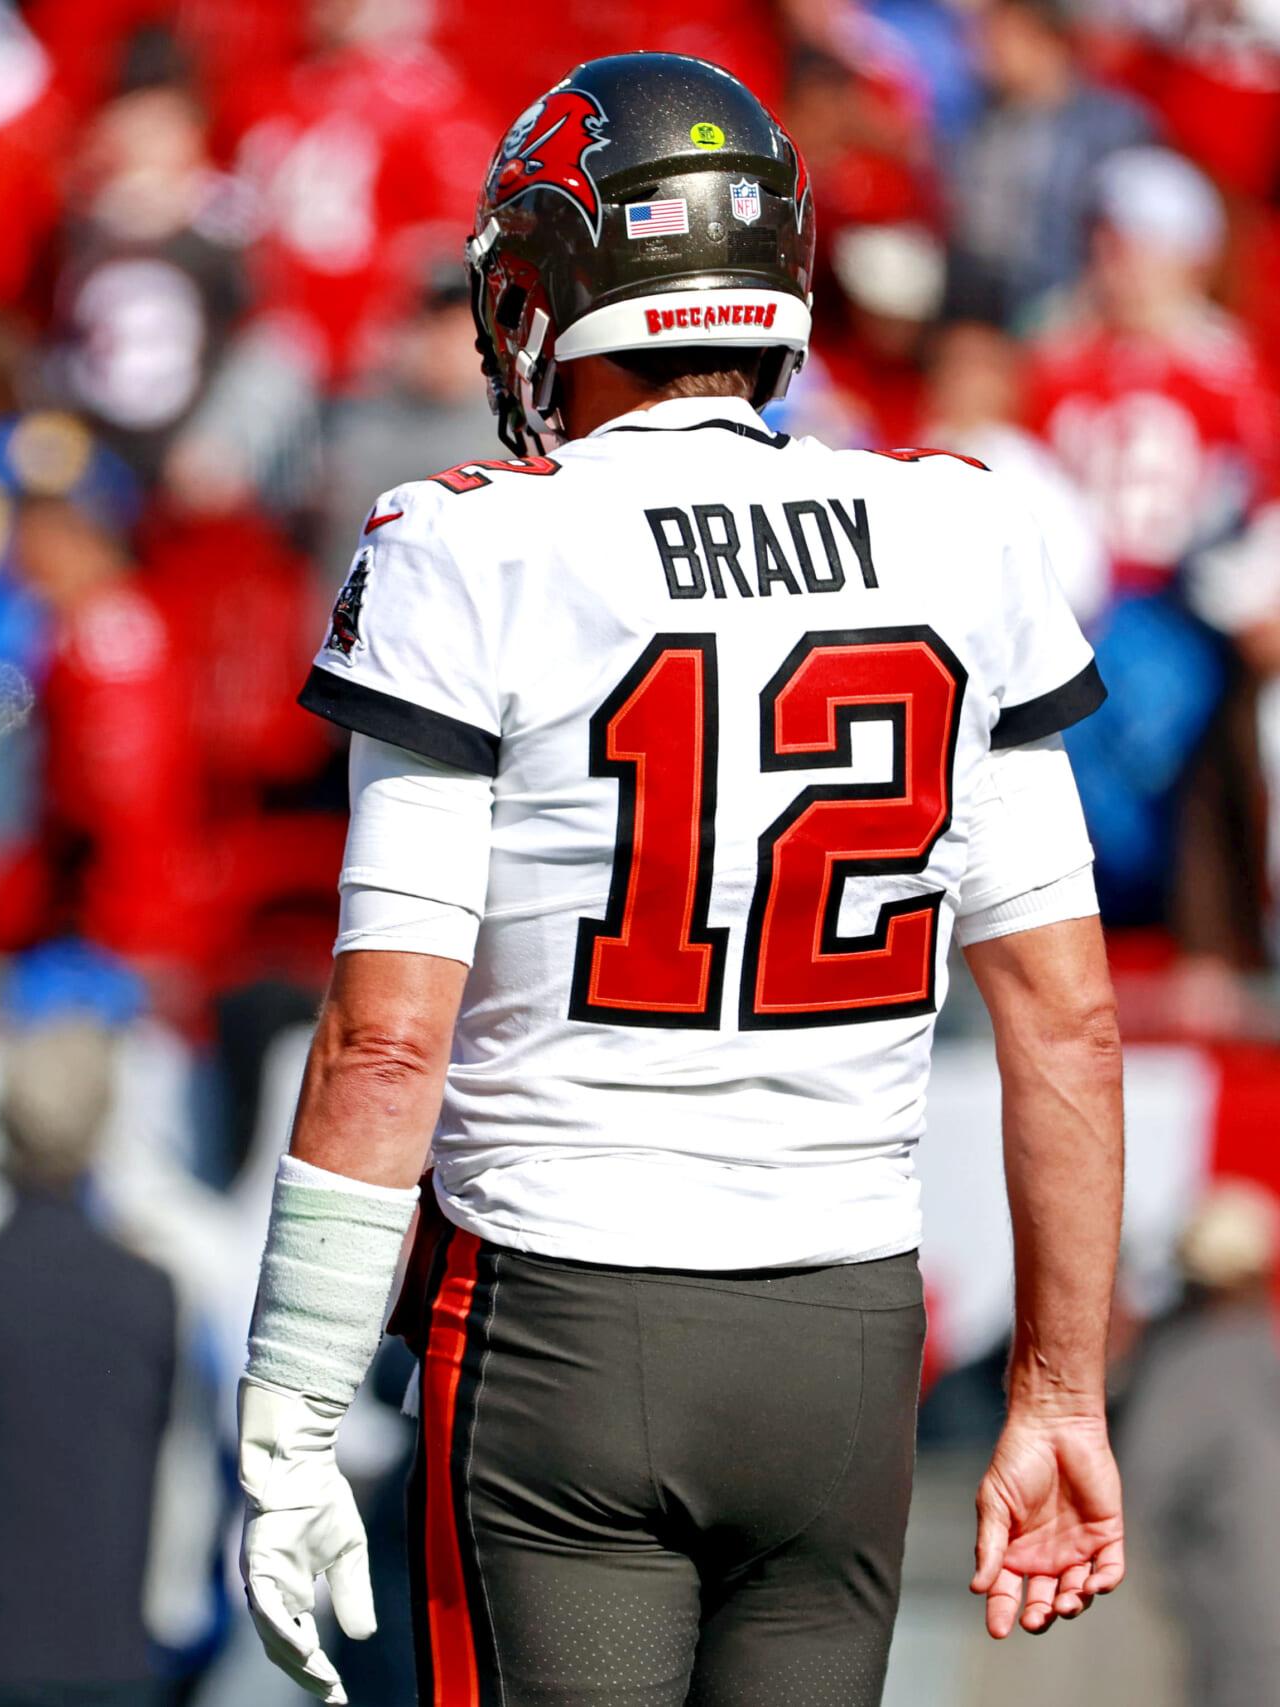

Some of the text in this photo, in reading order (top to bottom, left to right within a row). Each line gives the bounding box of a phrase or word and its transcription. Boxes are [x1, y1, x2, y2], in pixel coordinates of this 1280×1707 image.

[736, 200, 757, 214] NFL
[644, 303, 778, 335] BUCCANEERS
[643, 498, 879, 600] BRADY
[568, 624, 969, 1031] 12
